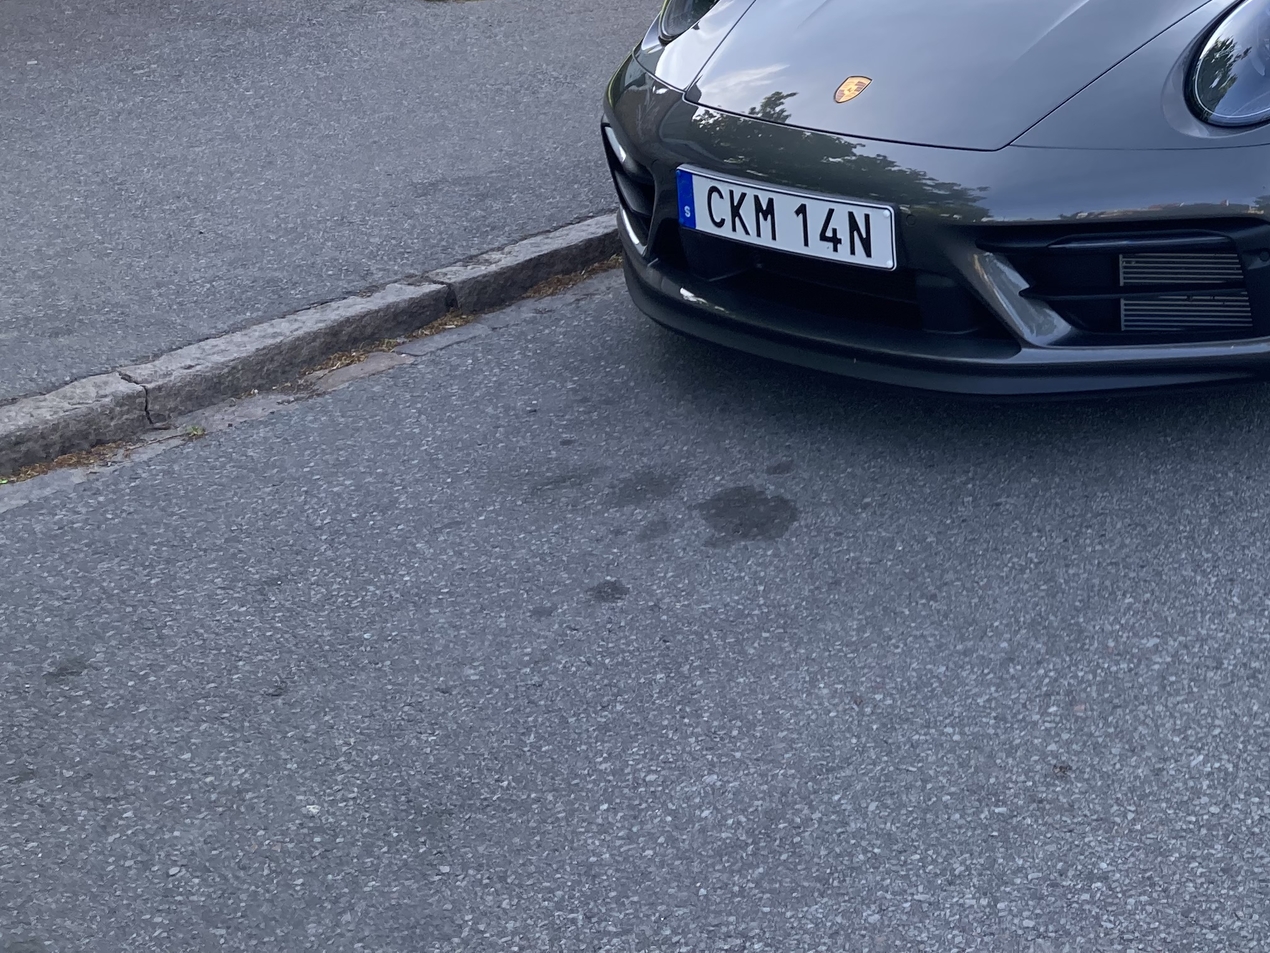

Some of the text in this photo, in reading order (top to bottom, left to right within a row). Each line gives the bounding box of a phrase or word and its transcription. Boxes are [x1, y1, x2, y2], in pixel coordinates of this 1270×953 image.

[684, 205, 691, 218] S
[707, 185, 872, 258] CKM 14N
